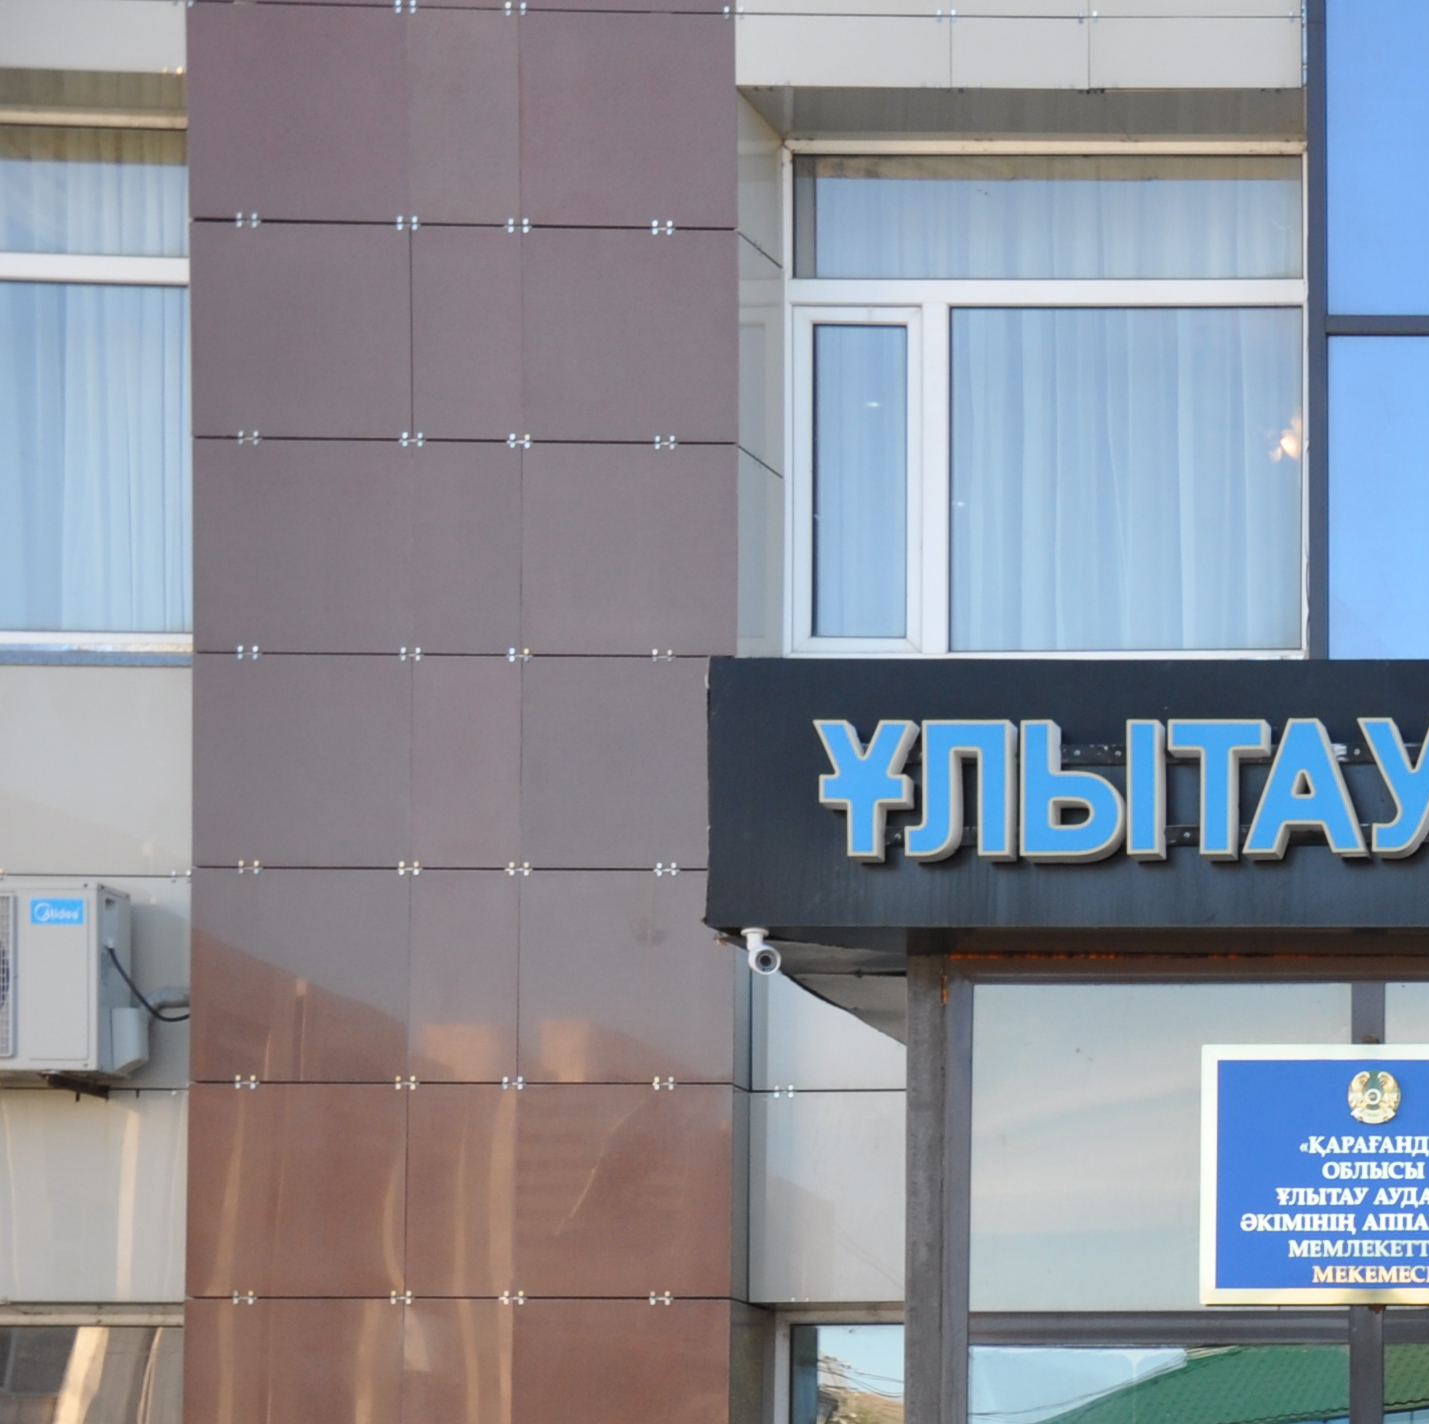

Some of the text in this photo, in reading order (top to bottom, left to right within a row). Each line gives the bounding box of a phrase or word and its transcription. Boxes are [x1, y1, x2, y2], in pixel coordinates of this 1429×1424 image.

[1321, 1161, 1426, 1180] ОБЛЫСЫ
[1275, 1187, 1369, 1206] ҰЛЫТАУ
[1239, 1213, 1357, 1236] ӘКІМІНІҢ
